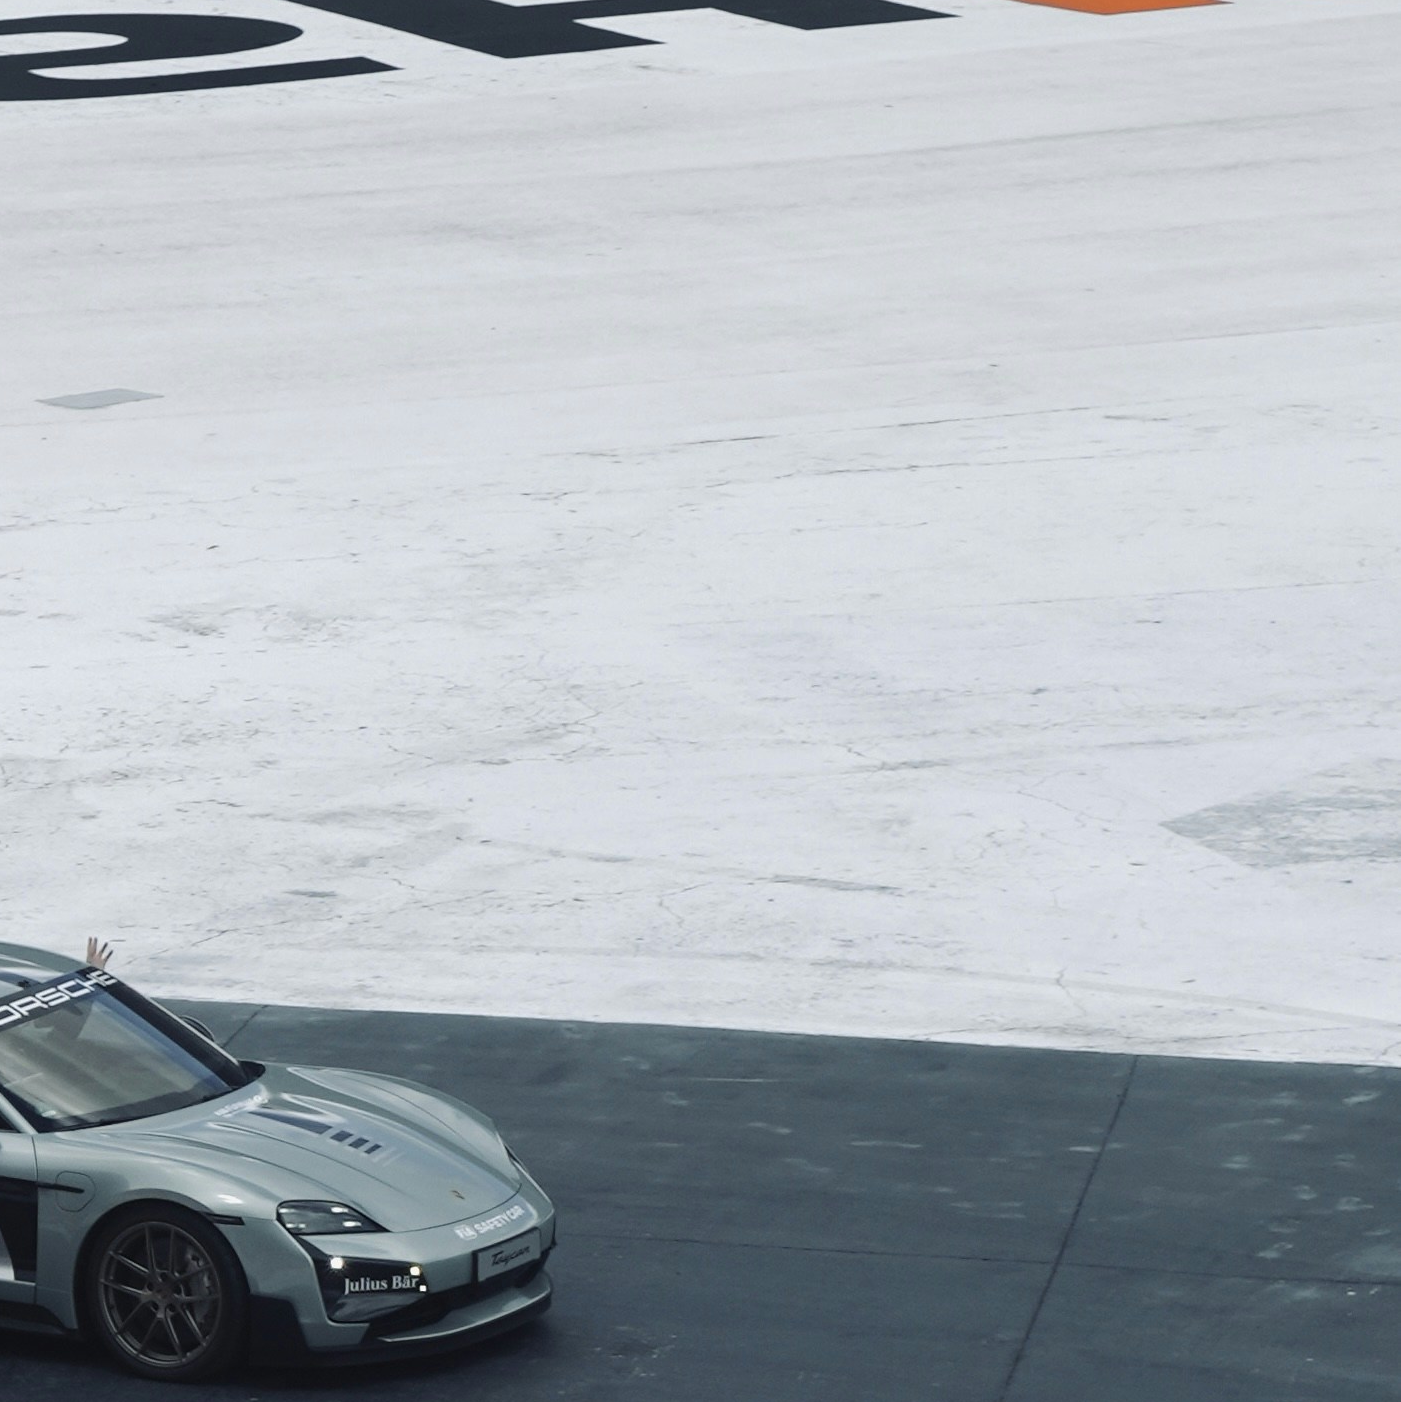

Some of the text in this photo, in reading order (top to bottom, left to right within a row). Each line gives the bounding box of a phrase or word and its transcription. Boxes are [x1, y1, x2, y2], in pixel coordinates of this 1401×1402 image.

[473, 1213, 511, 1234] SAFETY
[505, 1205, 525, 1220] CAR
[344, 1275, 420, 1296] Julius Bär
